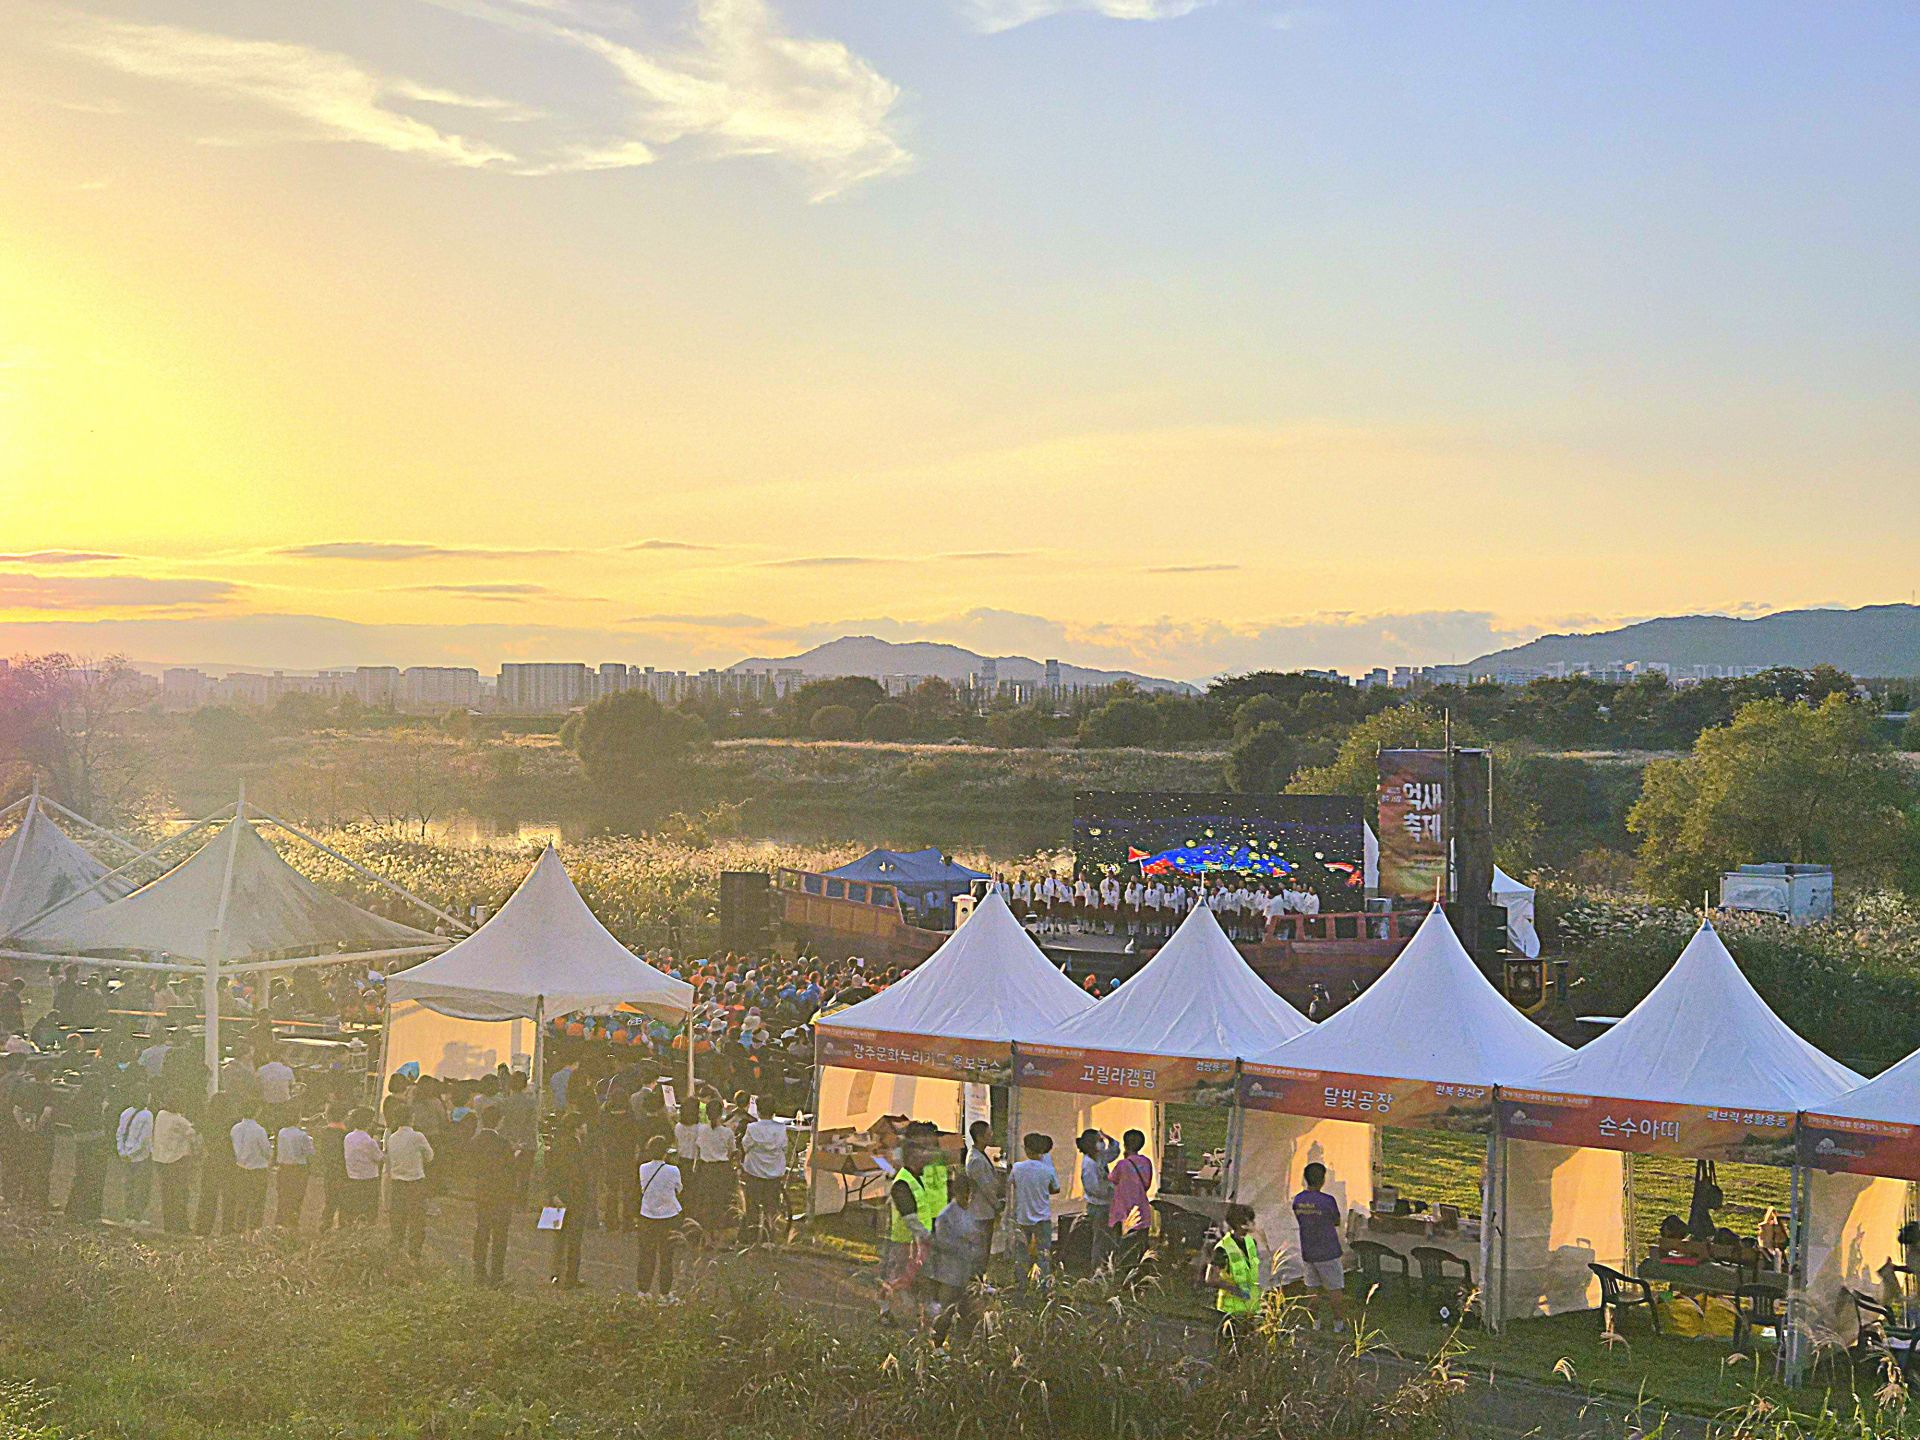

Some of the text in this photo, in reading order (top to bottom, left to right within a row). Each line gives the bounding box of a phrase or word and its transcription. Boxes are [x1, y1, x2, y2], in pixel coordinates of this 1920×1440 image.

[1402, 782, 1442, 811] 억새
[1402, 812, 1442, 843] 축제
[853, 1043, 947, 1067] 광주문화누리카드
[952, 1054, 1001, 1073] 홍보부스
[1079, 1064, 1157, 1090] 고릴라캠핑
[1324, 1086, 1394, 1113] 달빛공장
[1598, 1114, 1681, 1143] 손수아띠
